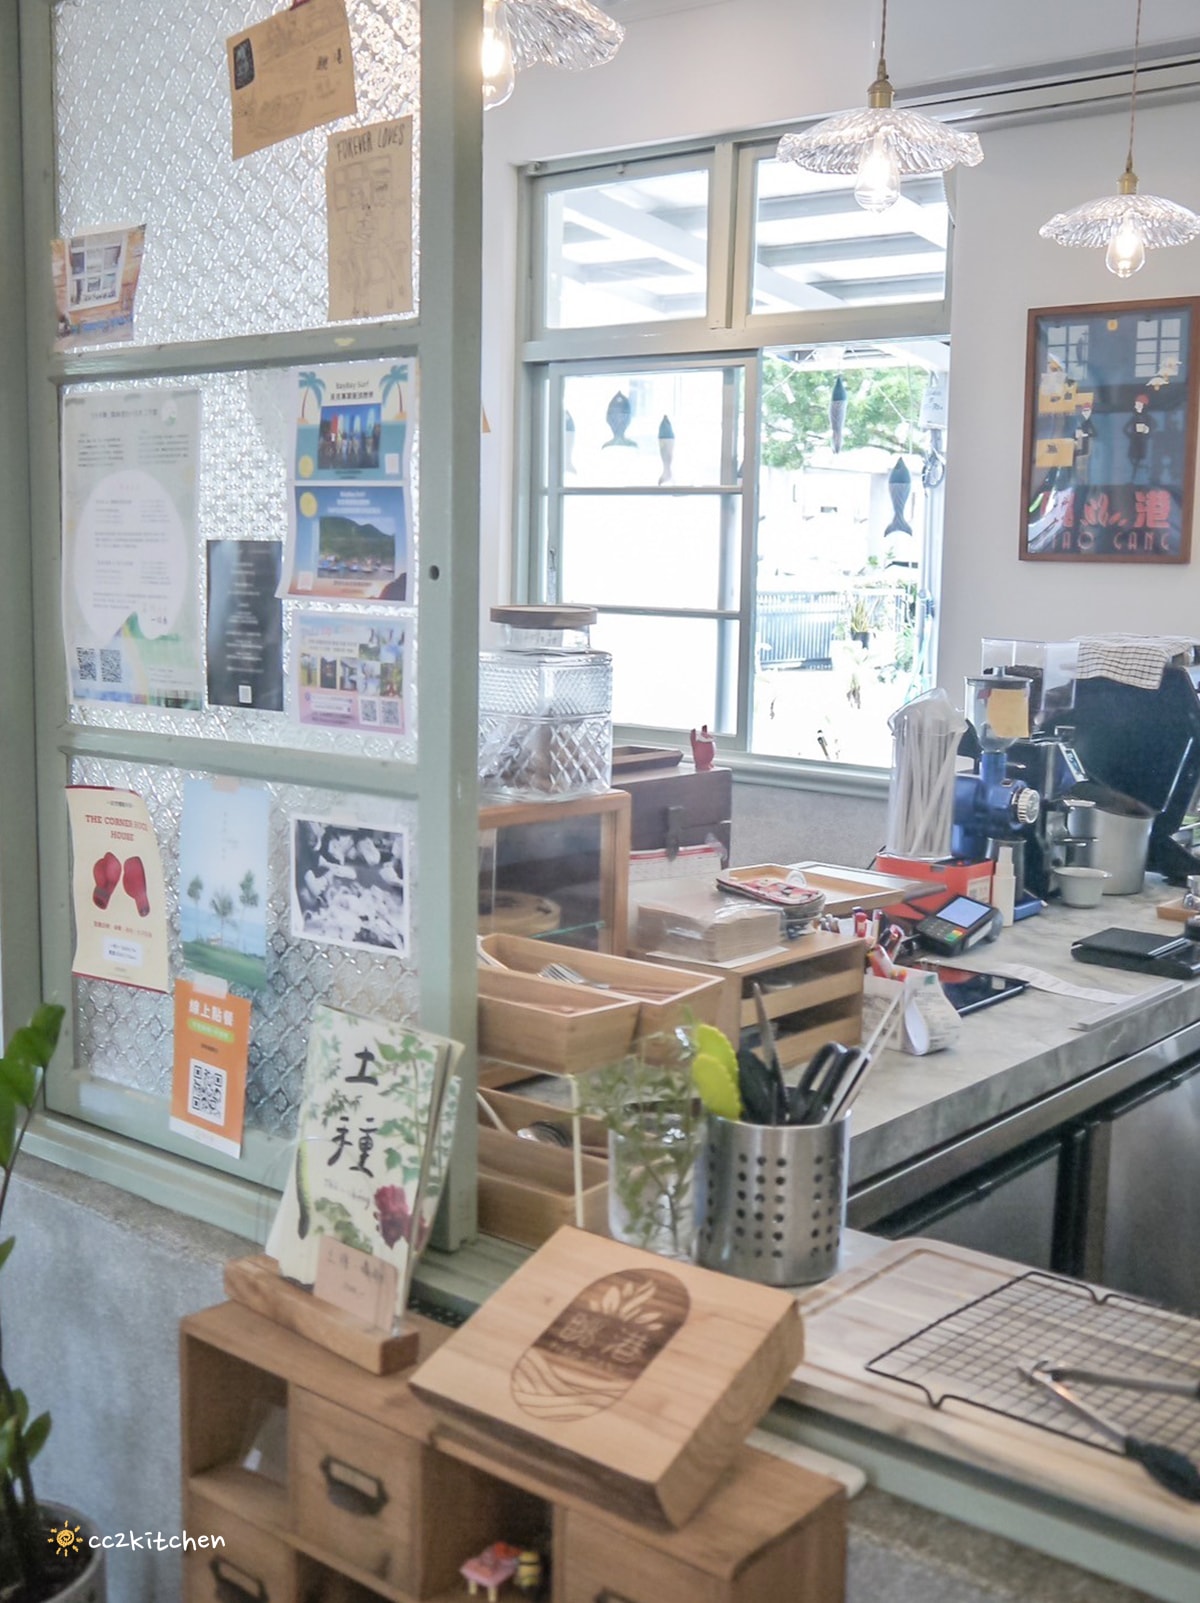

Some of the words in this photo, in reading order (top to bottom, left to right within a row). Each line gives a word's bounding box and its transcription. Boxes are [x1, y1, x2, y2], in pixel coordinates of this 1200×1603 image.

[336, 131, 373, 161] FOREVER
[377, 123, 405, 149] LOVES
[1112, 531, 1171, 551] GANG
[85, 814, 103, 824] THE
[188, 998, 234, 1027] 線上點餐
